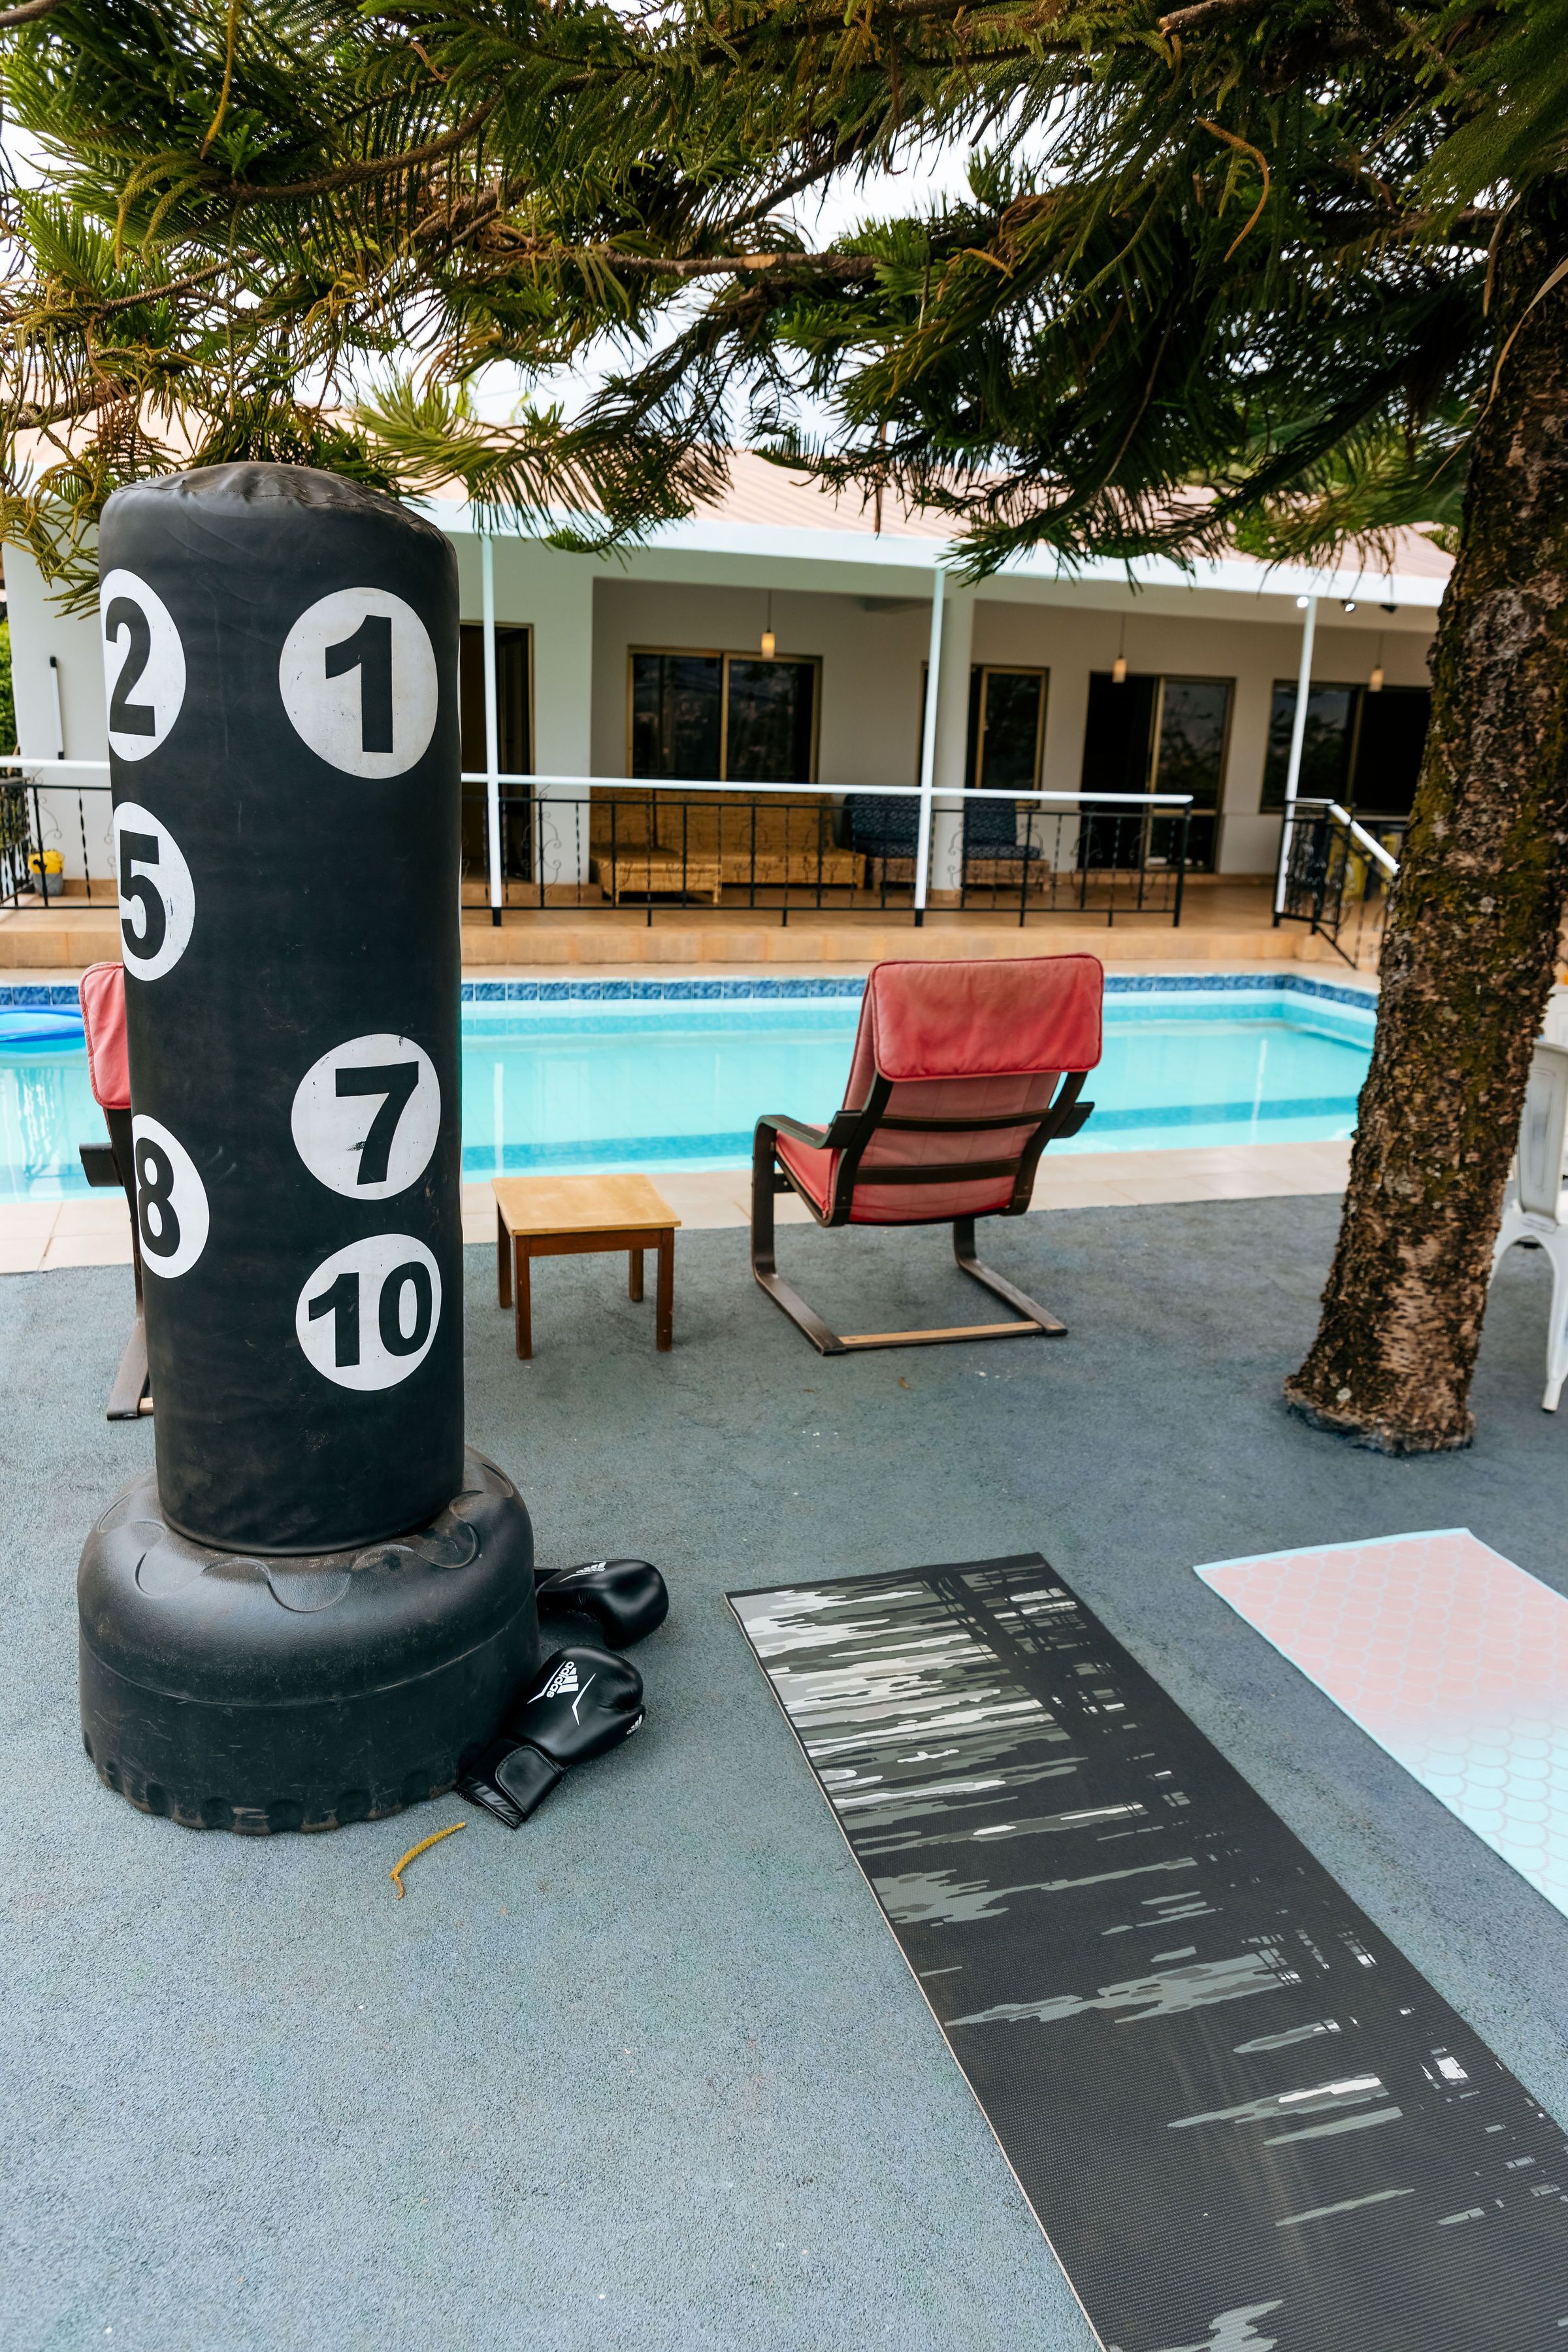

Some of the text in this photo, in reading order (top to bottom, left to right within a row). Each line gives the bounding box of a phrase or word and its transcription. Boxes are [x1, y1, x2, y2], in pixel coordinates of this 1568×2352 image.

[106, 597, 155, 736] 2
[325, 615, 393, 753] 1
[120, 830, 166, 960] 5
[336, 1061, 419, 1185] 7
[136, 1137, 180, 1257] 8
[308, 1262, 432, 1367] 10
[546, 1661, 574, 1698] adidas
